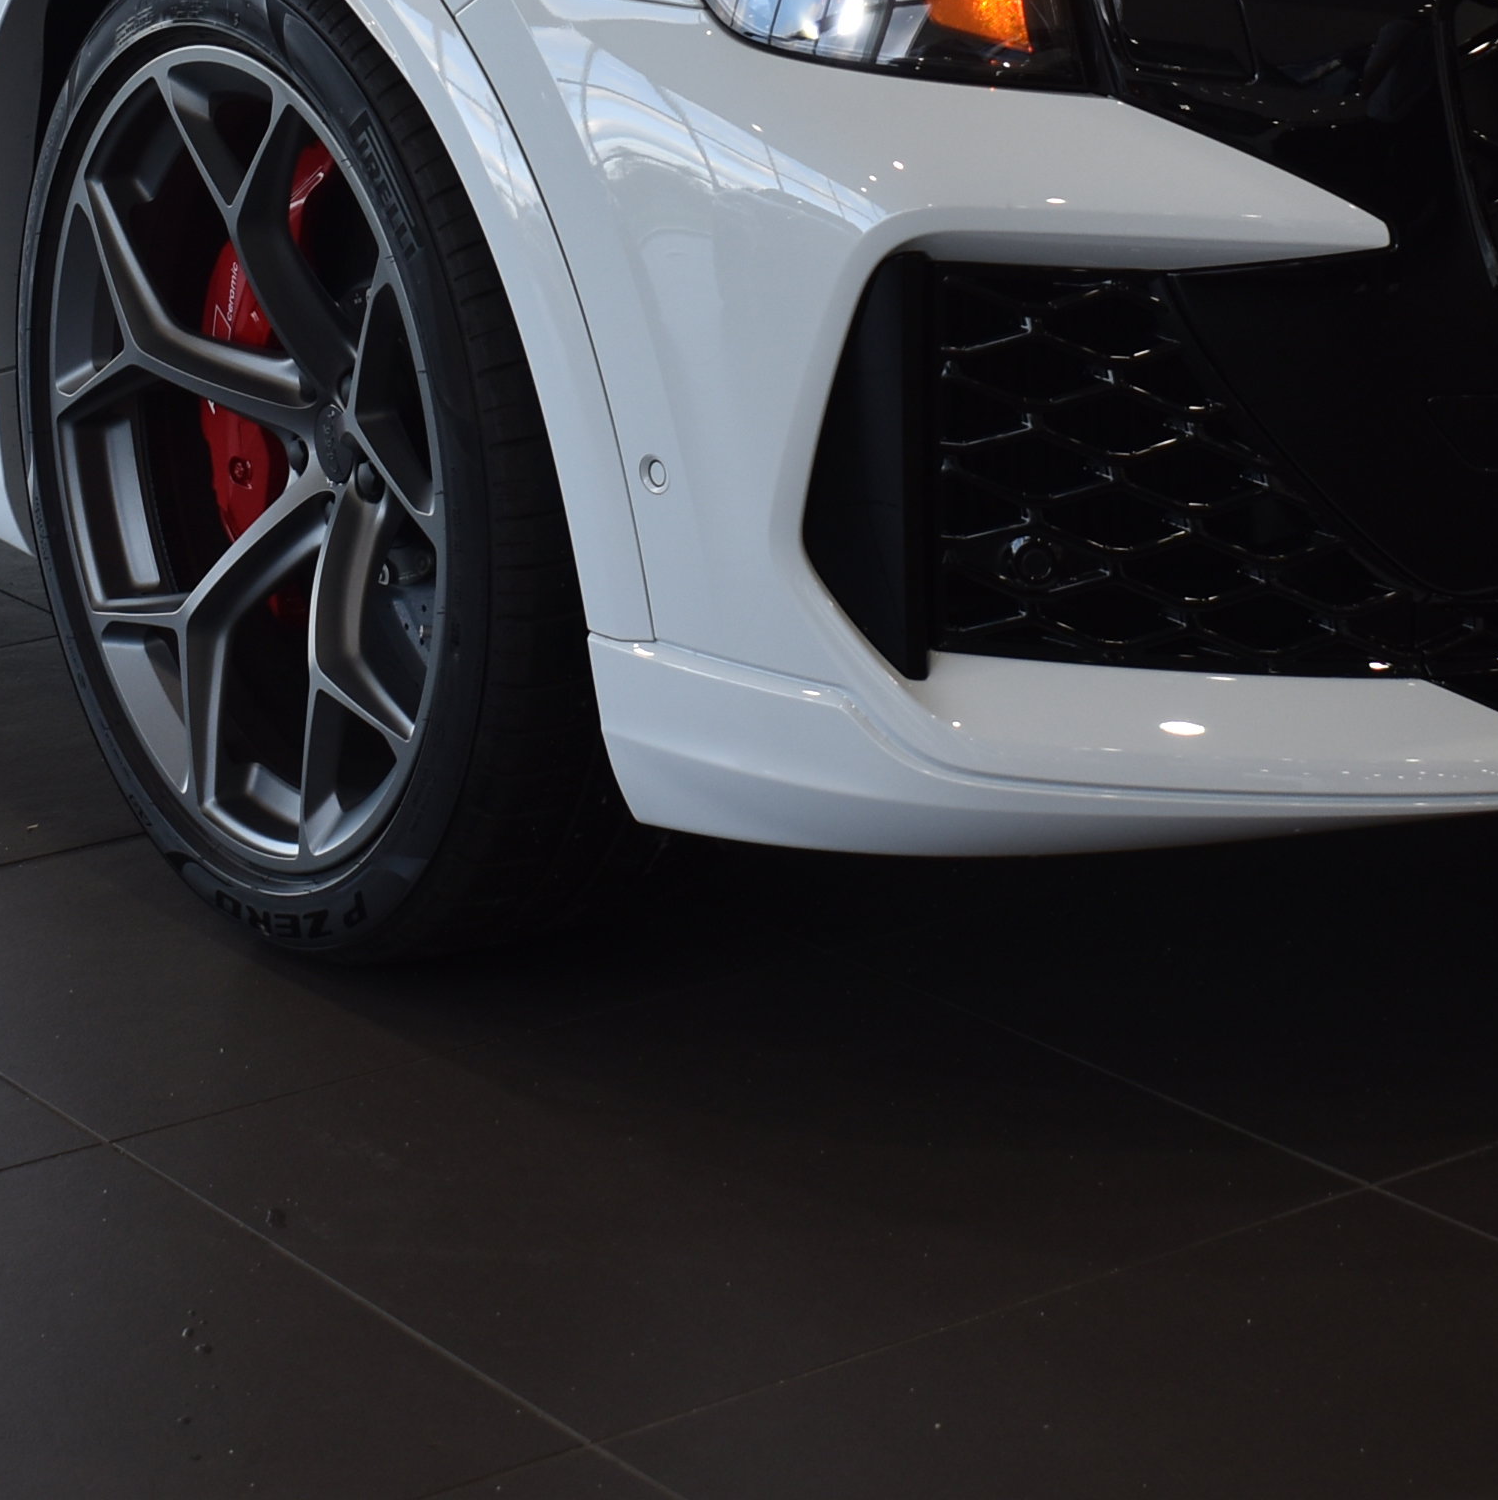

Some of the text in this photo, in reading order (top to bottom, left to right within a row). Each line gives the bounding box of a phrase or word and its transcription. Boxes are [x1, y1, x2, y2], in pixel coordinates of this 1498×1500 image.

[349, 111, 421, 261] PIRELLI
[226, 261, 239, 322] ceramic
[216, 890, 368, 939] P ZERO
